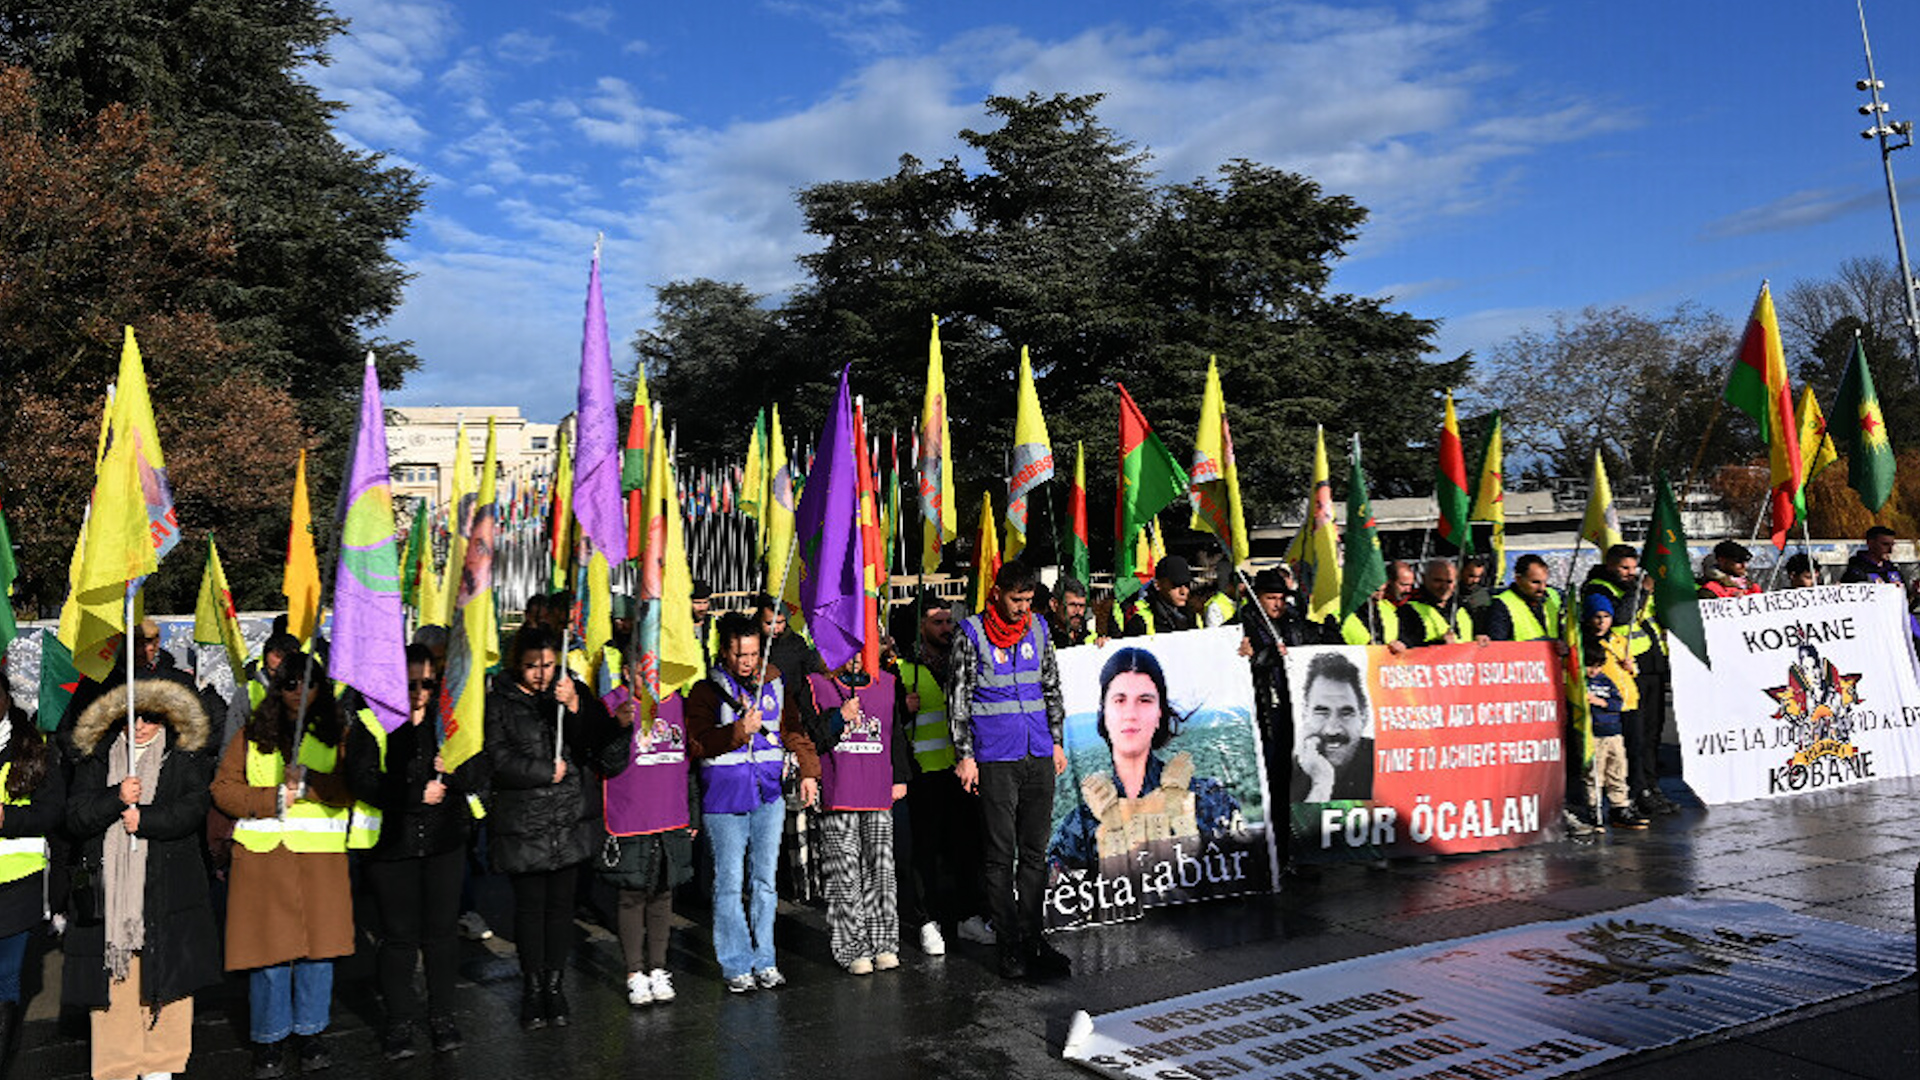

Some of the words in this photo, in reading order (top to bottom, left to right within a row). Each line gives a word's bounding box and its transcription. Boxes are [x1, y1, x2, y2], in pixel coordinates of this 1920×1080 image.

[1737, 597, 1762, 617] LA
[1764, 586, 1858, 612] RESISTANCE
[1743, 617, 1855, 653] KOBANE
[1436, 662, 1475, 688] STOP
[1379, 704, 1444, 731] FASCISM
[1447, 704, 1475, 728] AND
[1478, 699, 1558, 726] OCCUPATION
[1378, 748, 1414, 773] TIME
[1418, 746, 1436, 770] TO
[1439, 742, 1497, 769] ACHIEVE
[1500, 738, 1561, 765] FREEDOM
[1696, 730, 1738, 754] VIVE
[1741, 727, 1766, 750] LA
[1769, 750, 1876, 794] KOBANE
[1321, 807, 1397, 849] FOR
[1410, 795, 1539, 843] ÖCALAN
[1132, 991, 1302, 1033] FASCISM
[1300, 989, 1424, 1022] TODAY
[1247, 1009, 1457, 1066] YESTERDAY
[1354, 1035, 1488, 1072] TODAY
